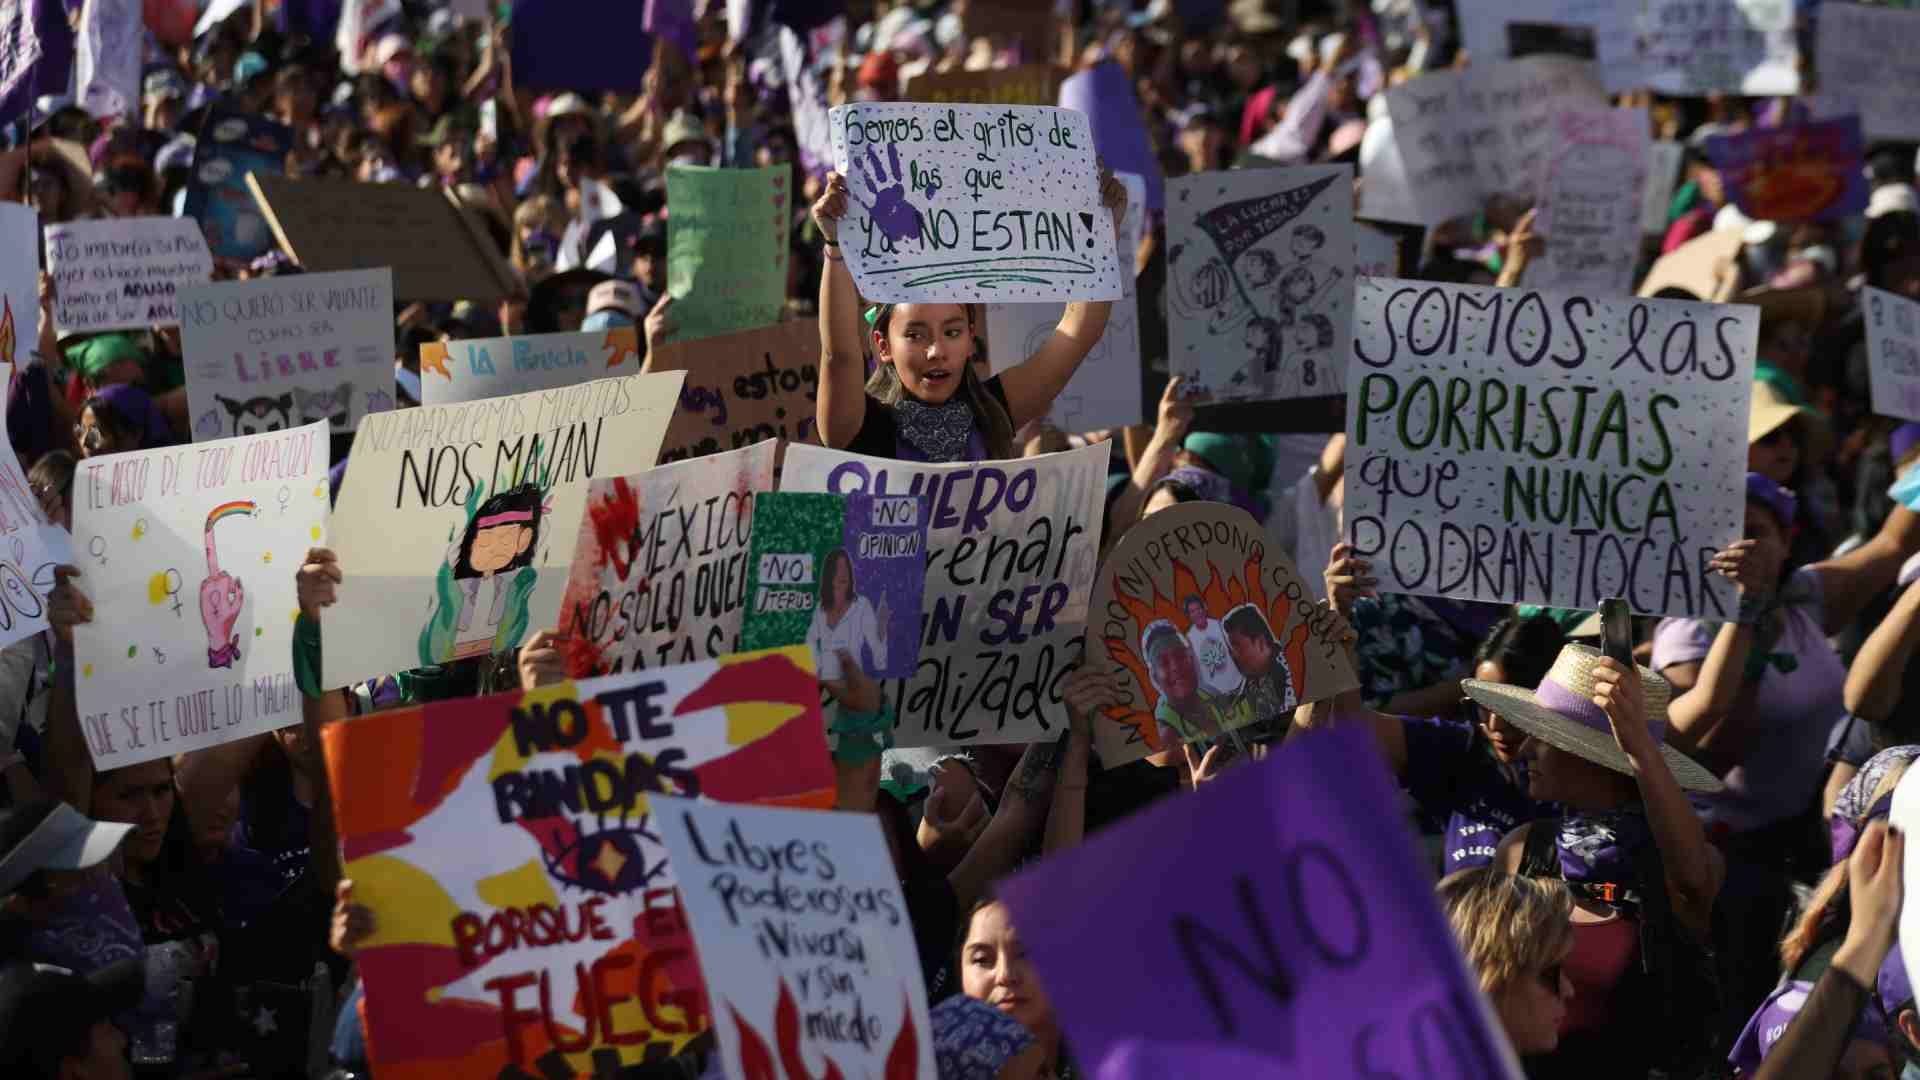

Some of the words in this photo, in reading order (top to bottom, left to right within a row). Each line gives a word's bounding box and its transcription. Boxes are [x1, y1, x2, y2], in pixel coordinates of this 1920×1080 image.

[845, 109, 924, 146] Somos
[933, 109, 965, 141] el
[973, 109, 1035, 162] grito
[1048, 112, 1077, 149] de
[910, 159, 943, 193] las
[964, 167, 1005, 203] que
[1240, 193, 1288, 219] LUCHA
[919, 208, 960, 250] NO
[123, 281, 177, 298] ABUSO
[181, 300, 217, 329] NO
[467, 343, 497, 376] LA
[1354, 286, 1594, 368] SOMOS
[1610, 303, 1741, 381] las
[733, 351, 819, 403] estoy
[1302, 358, 1316, 387] 8
[1356, 372, 1680, 476] PORRISTAS
[87, 464, 105, 510] TE
[161, 451, 185, 497] DE
[396, 441, 483, 509] NOS
[490, 416, 603, 498] MATAN
[1359, 454, 1461, 517] que
[1503, 465, 1683, 542] NUNCA
[627, 482, 754, 580] MÉXICO
[1120, 555, 1151, 594] NI
[568, 590, 611, 644] NO
[979, 580, 1072, 646] SER
[85, 711, 117, 758] QUE
[121, 706, 145, 750] SE
[149, 700, 171, 745] TE
[224, 683, 243, 726] LO
[508, 698, 590, 758] NO
[596, 680, 676, 744] TE
[490, 747, 702, 825] RINDAS
[681, 810, 836, 881] Libres
[711, 872, 900, 928] Poderosas
[450, 892, 618, 967] PORQUE
[1172, 839, 1371, 1040] NO
[805, 996, 883, 1052] miedo
